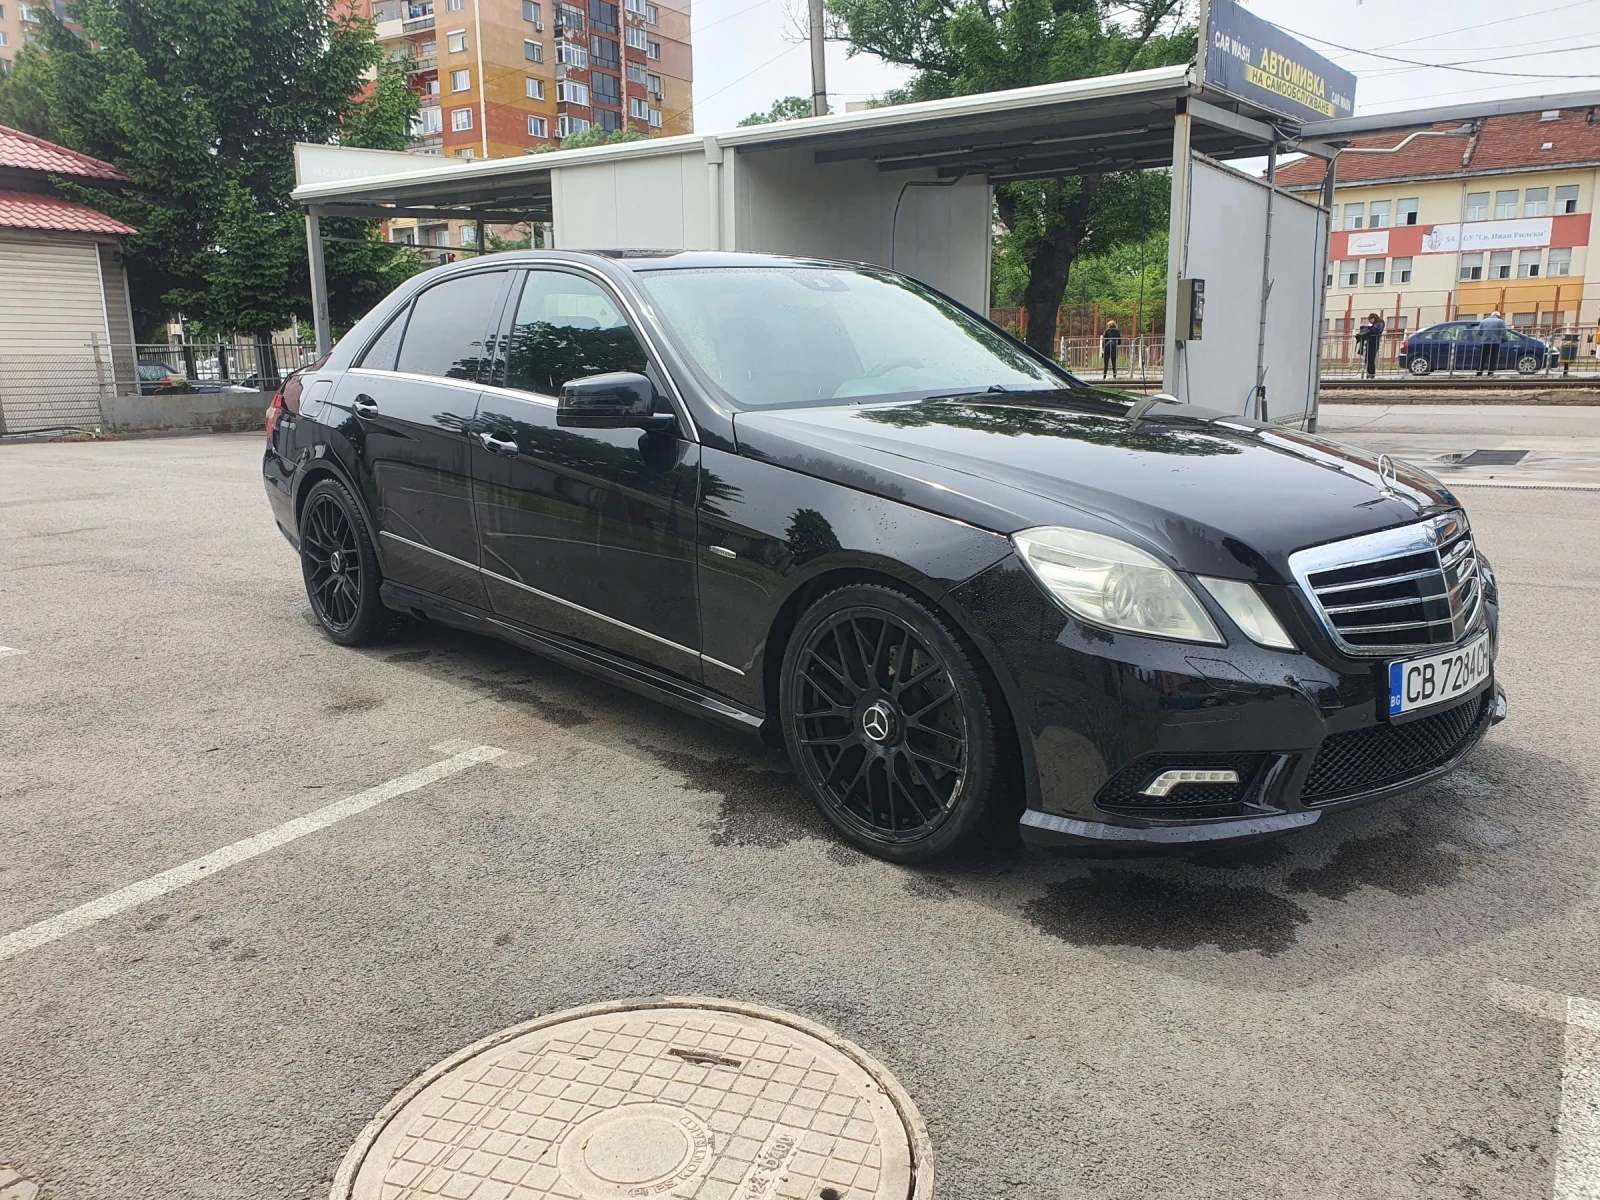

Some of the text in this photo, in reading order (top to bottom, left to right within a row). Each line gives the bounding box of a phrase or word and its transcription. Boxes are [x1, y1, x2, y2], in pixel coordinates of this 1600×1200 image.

[1215, 31, 1250, 63] CAR WASH
[1252, 70, 1330, 115] НА САМООБСЛУЖВАНЕ
[1260, 47, 1325, 99] АВТОМИВКА
[1406, 637, 1489, 703] CB 7284 CH
[1390, 695, 1400, 707] BG
